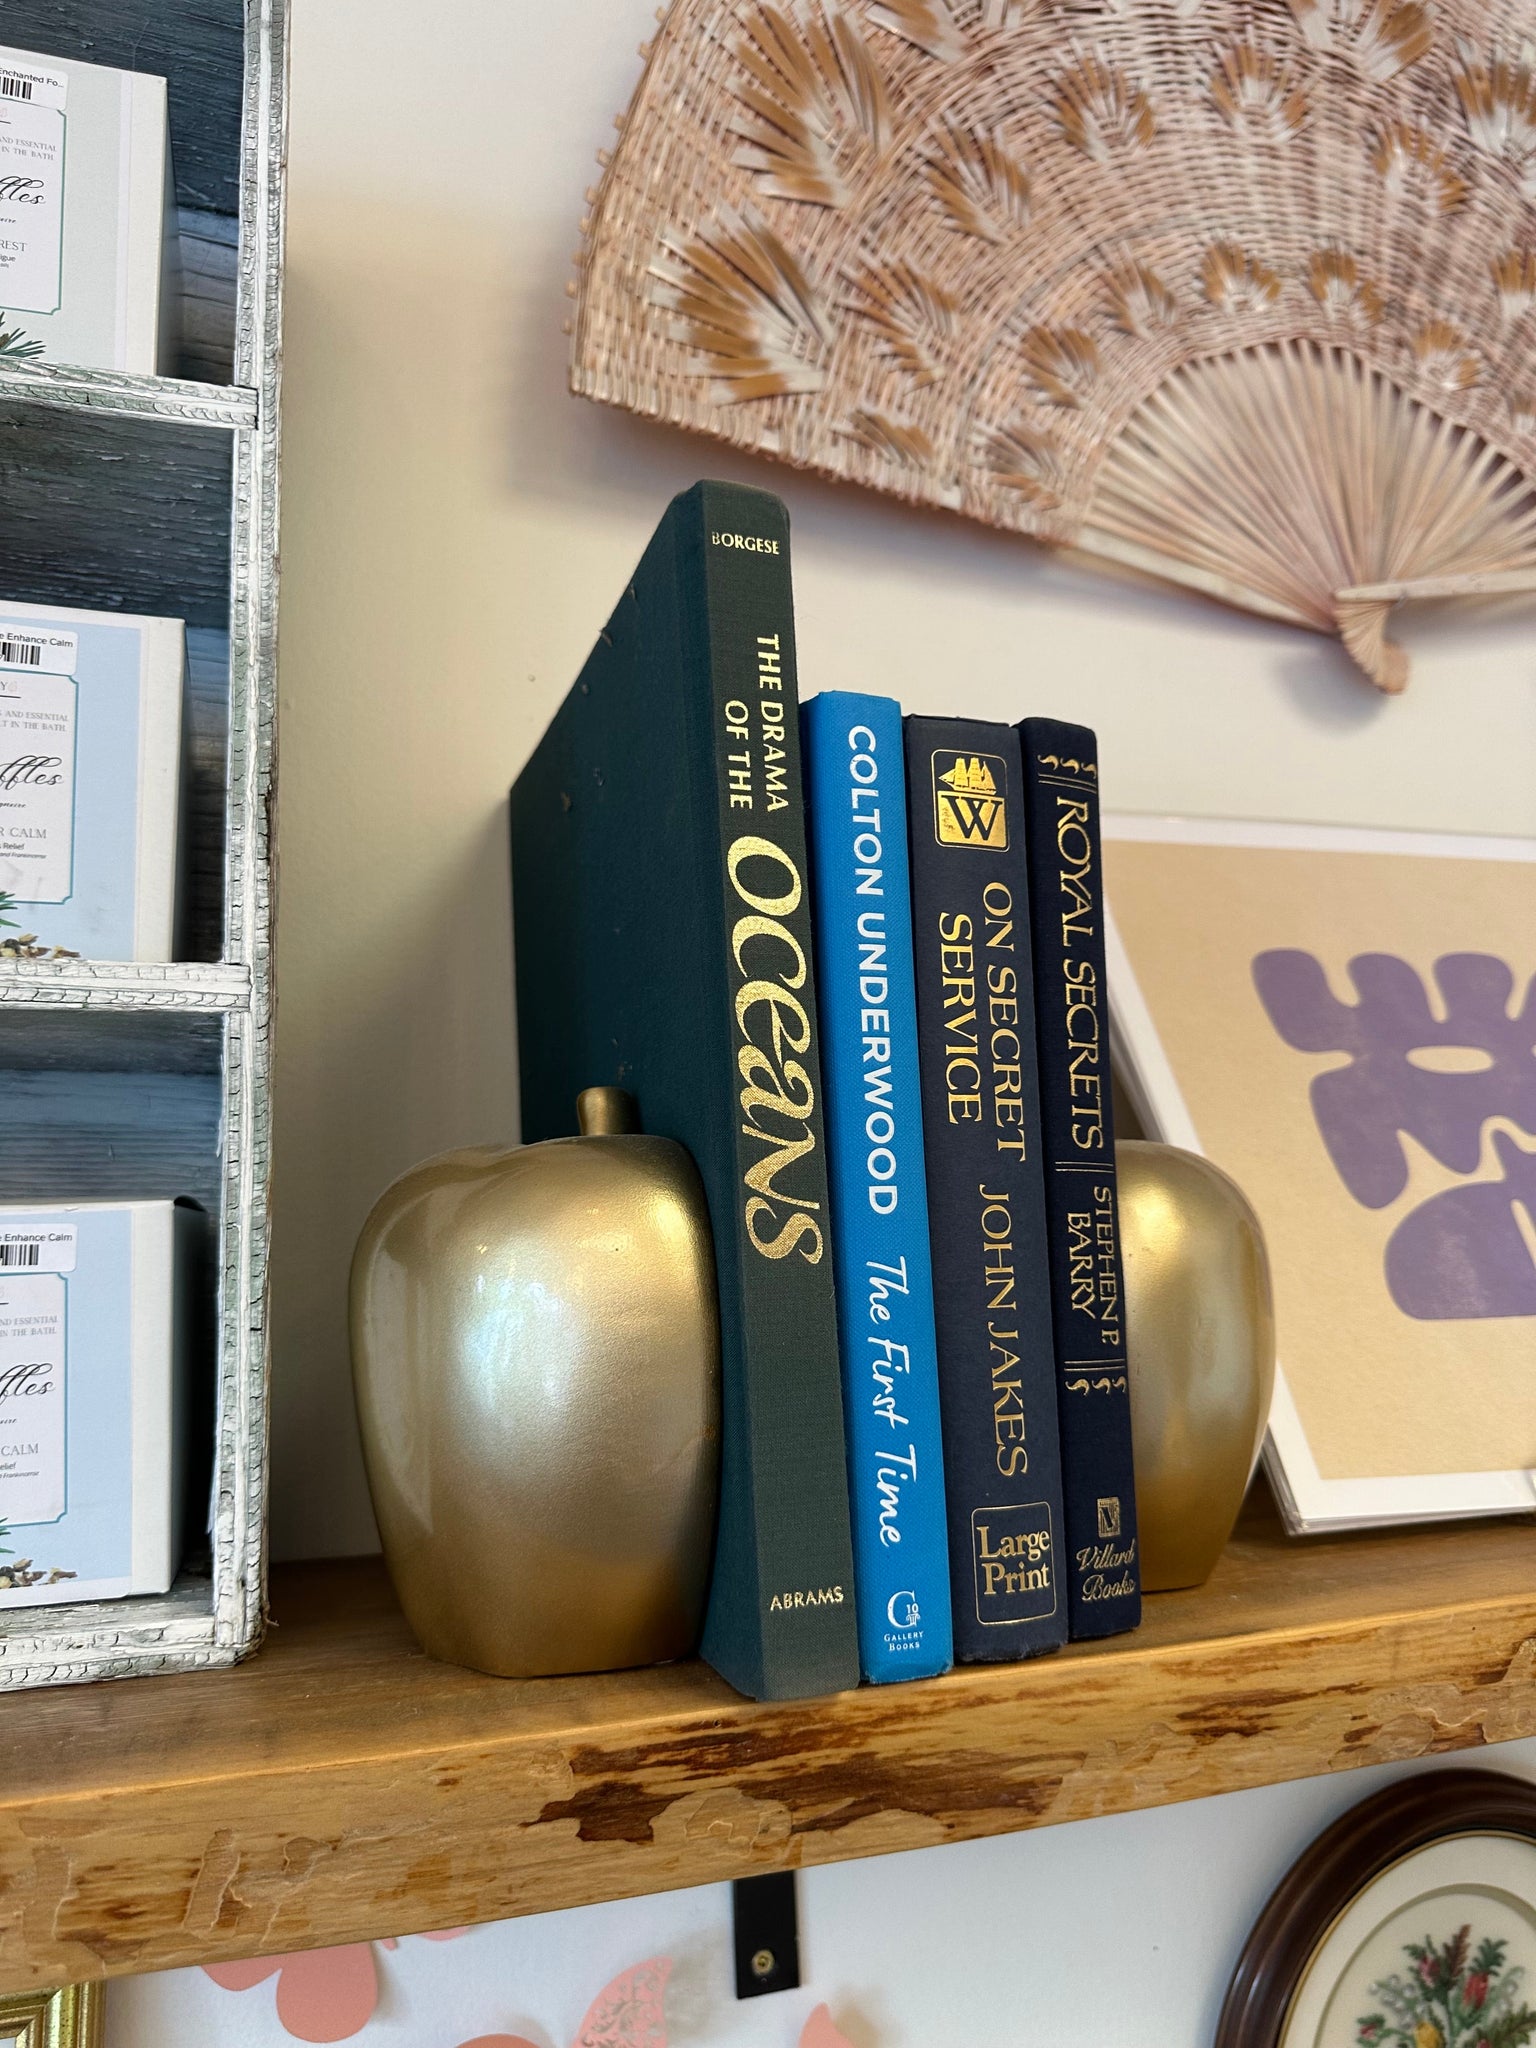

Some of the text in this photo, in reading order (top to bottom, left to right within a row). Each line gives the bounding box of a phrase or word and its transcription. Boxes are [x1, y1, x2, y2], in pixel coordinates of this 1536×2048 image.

[712, 531, 780, 555] BORGESE
[7, 633, 48, 645] Enhance
[49, 638, 73, 648] Calm
[757, 634, 789, 812] THE DRAMA
[725, 700, 753, 810] OF THE
[9, 827, 47, 839] CALM
[941, 794, 1003, 841] W
[849, 725, 898, 1216] COLTON UNDERWOOD
[1056, 796, 1105, 1151] ROYAL SECRETS
[938, 911, 982, 1125] SERVICE
[982, 881, 1026, 1162] ON SECRET
[4, 1233, 46, 1242] Enhance
[48, 1233, 73, 1242] Calm
[1065, 1211, 1097, 1320] BARRY
[1093, 1185, 1120, 1346] STEPHEN P.
[978, 1183, 1029, 1477] JOHN JAKES
[866, 1255, 917, 1548] The First Time
[0, 1442, 39, 1457] CALM
[976, 1525, 1050, 1562] Large
[1075, 1537, 1136, 1571] Villard
[981, 1561, 1051, 1596] Print
[1081, 1569, 1136, 1601] Books
[770, 1586, 845, 1611] ABRAMS
[883, 1631, 924, 1642] GALLERY
[889, 1641, 920, 1652] BOOKS
